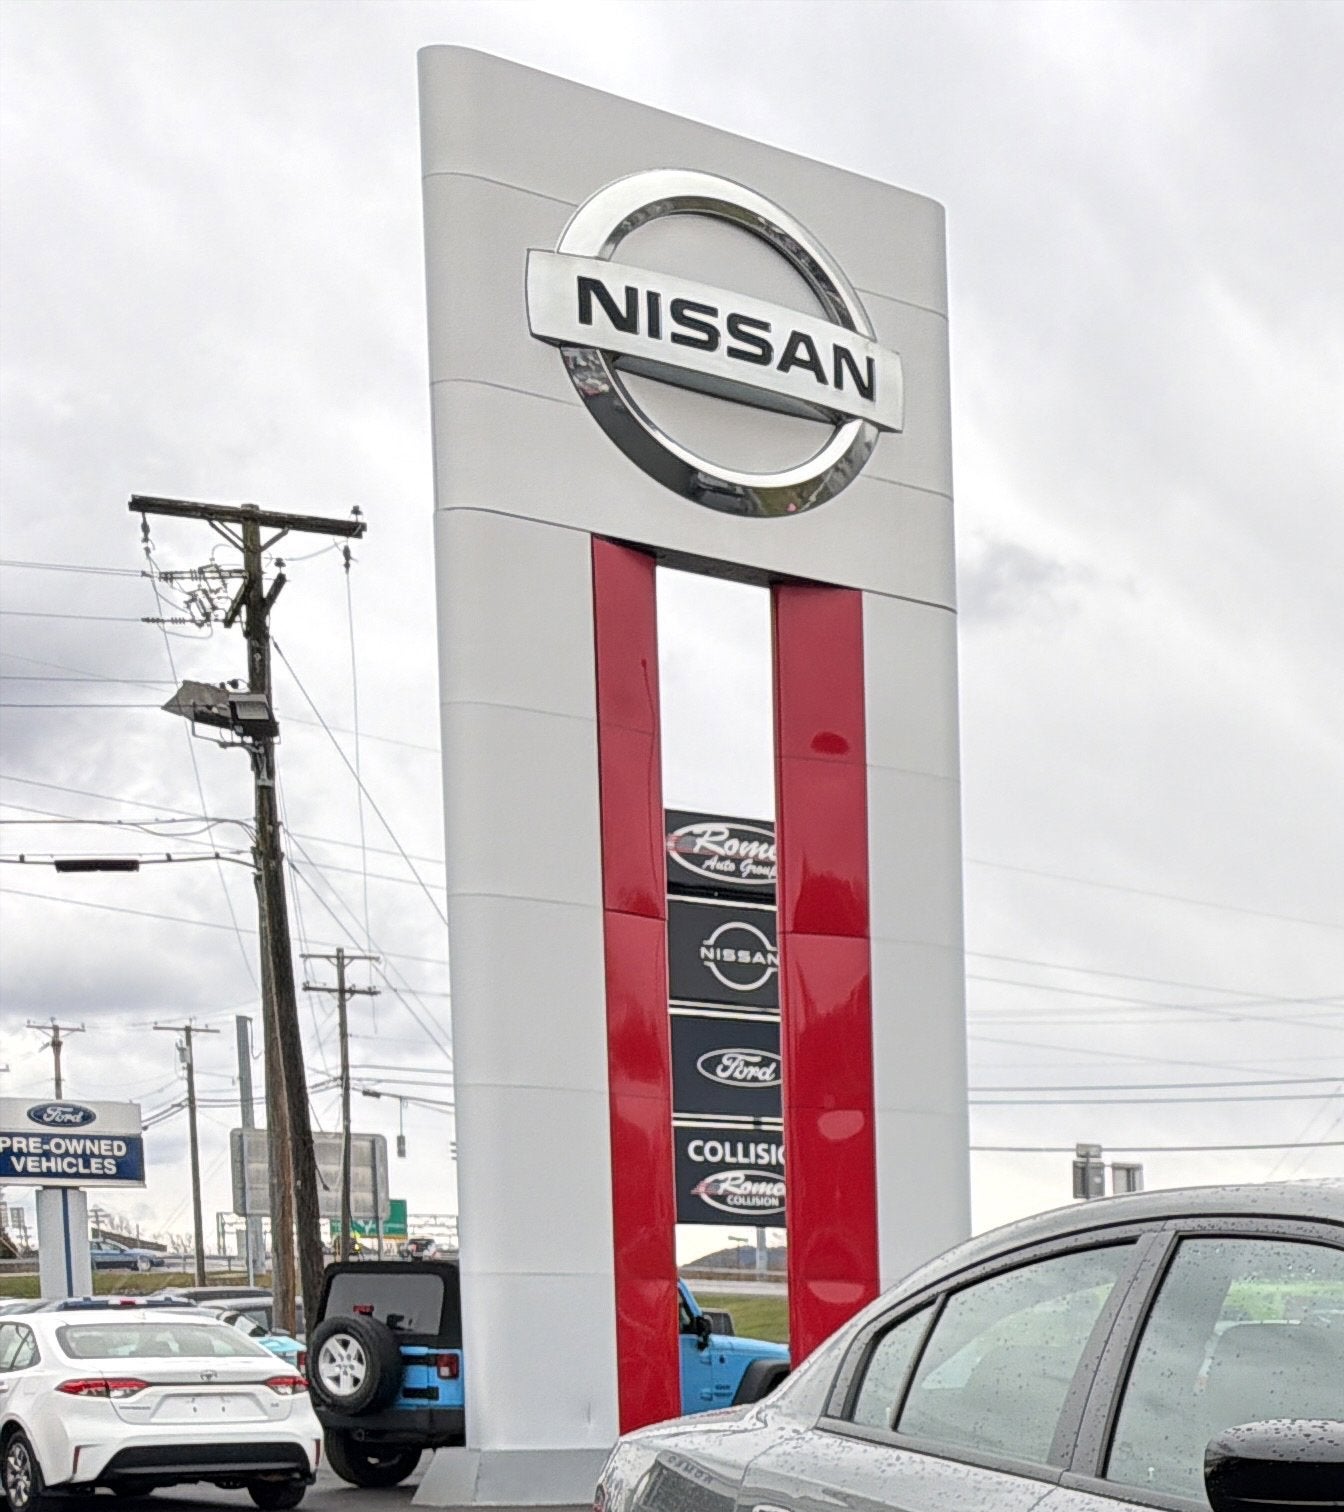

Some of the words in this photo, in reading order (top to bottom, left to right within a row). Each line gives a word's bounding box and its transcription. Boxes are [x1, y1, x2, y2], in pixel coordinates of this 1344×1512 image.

[577, 275, 876, 402] NISSAN
[702, 855, 736, 872] Auto
[701, 946, 778, 966] NISSAN
[716, 1053, 775, 1081] Ford
[43, 1106, 83, 1122] Ford
[0, 1136, 127, 1157] PRE-OWNED
[10, 1156, 117, 1175] VEHICLES
[727, 1194, 779, 1208] COLLISION
